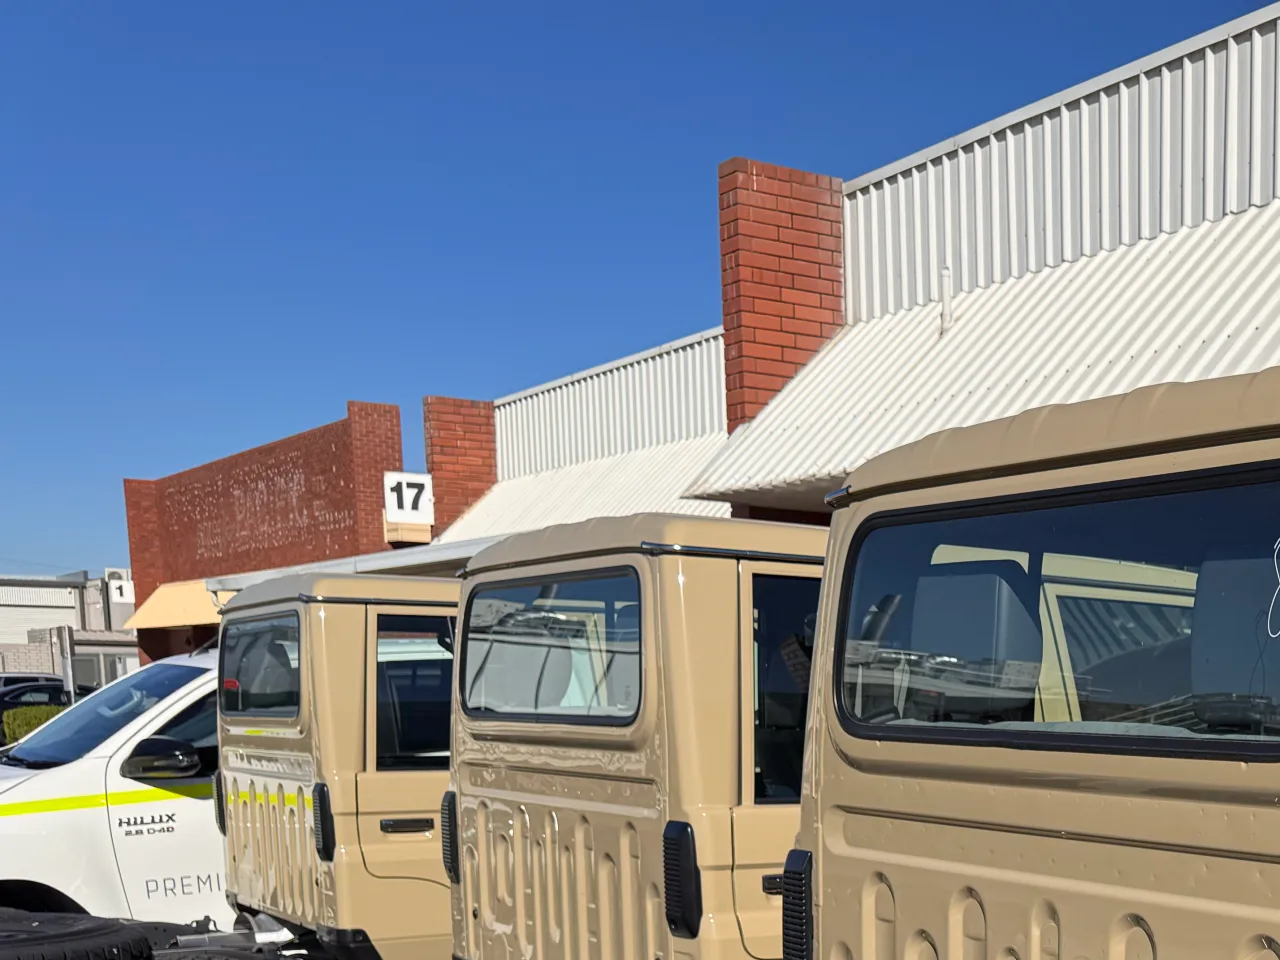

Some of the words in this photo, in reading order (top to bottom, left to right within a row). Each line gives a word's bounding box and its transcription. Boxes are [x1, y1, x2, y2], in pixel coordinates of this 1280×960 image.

[389, 481, 426, 511] 17
[115, 584, 125, 598] 1
[118, 813, 176, 827] HILUX
[145, 872, 221, 900] PREMI
